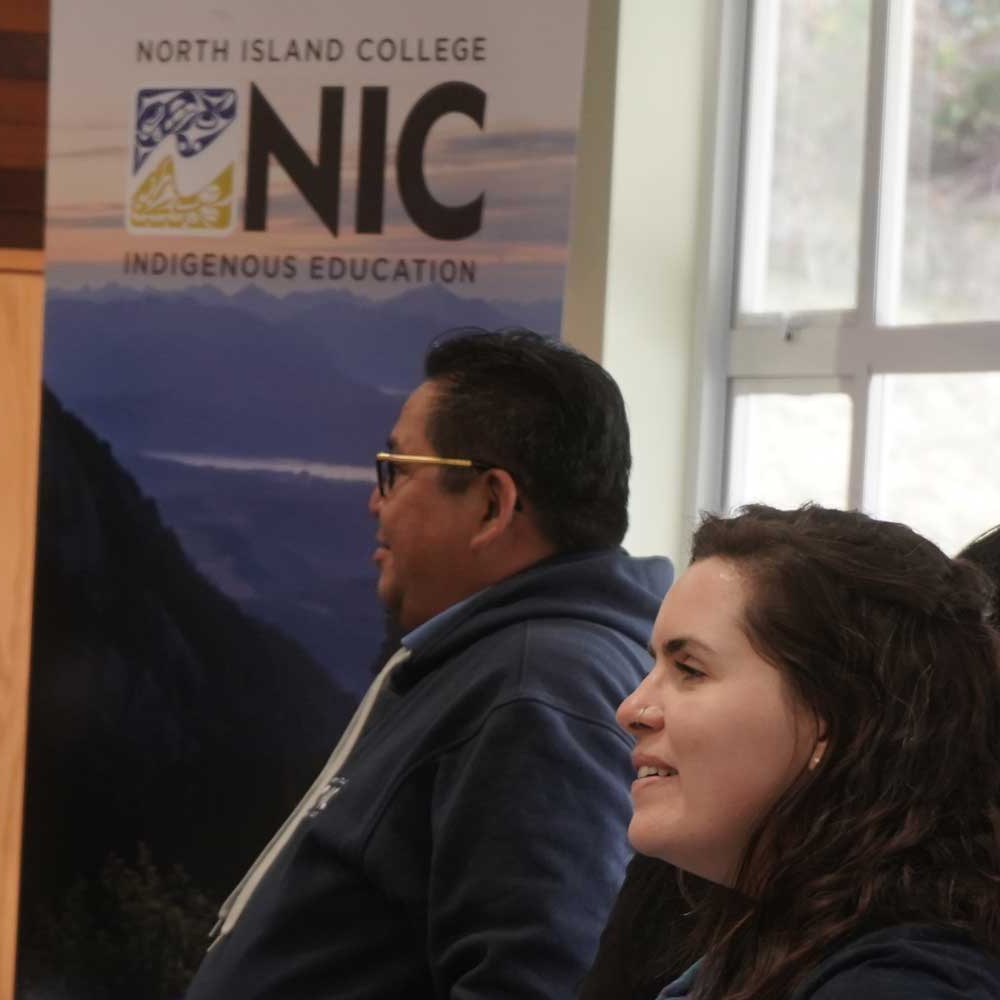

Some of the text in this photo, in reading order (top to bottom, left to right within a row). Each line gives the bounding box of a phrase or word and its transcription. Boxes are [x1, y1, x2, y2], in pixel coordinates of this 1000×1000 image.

[136, 37, 488, 63] NORTH ISLAND COLLEGE
[244, 81, 488, 241] NIC
[123, 251, 476, 284] INDIGENOUS EDUCATION
